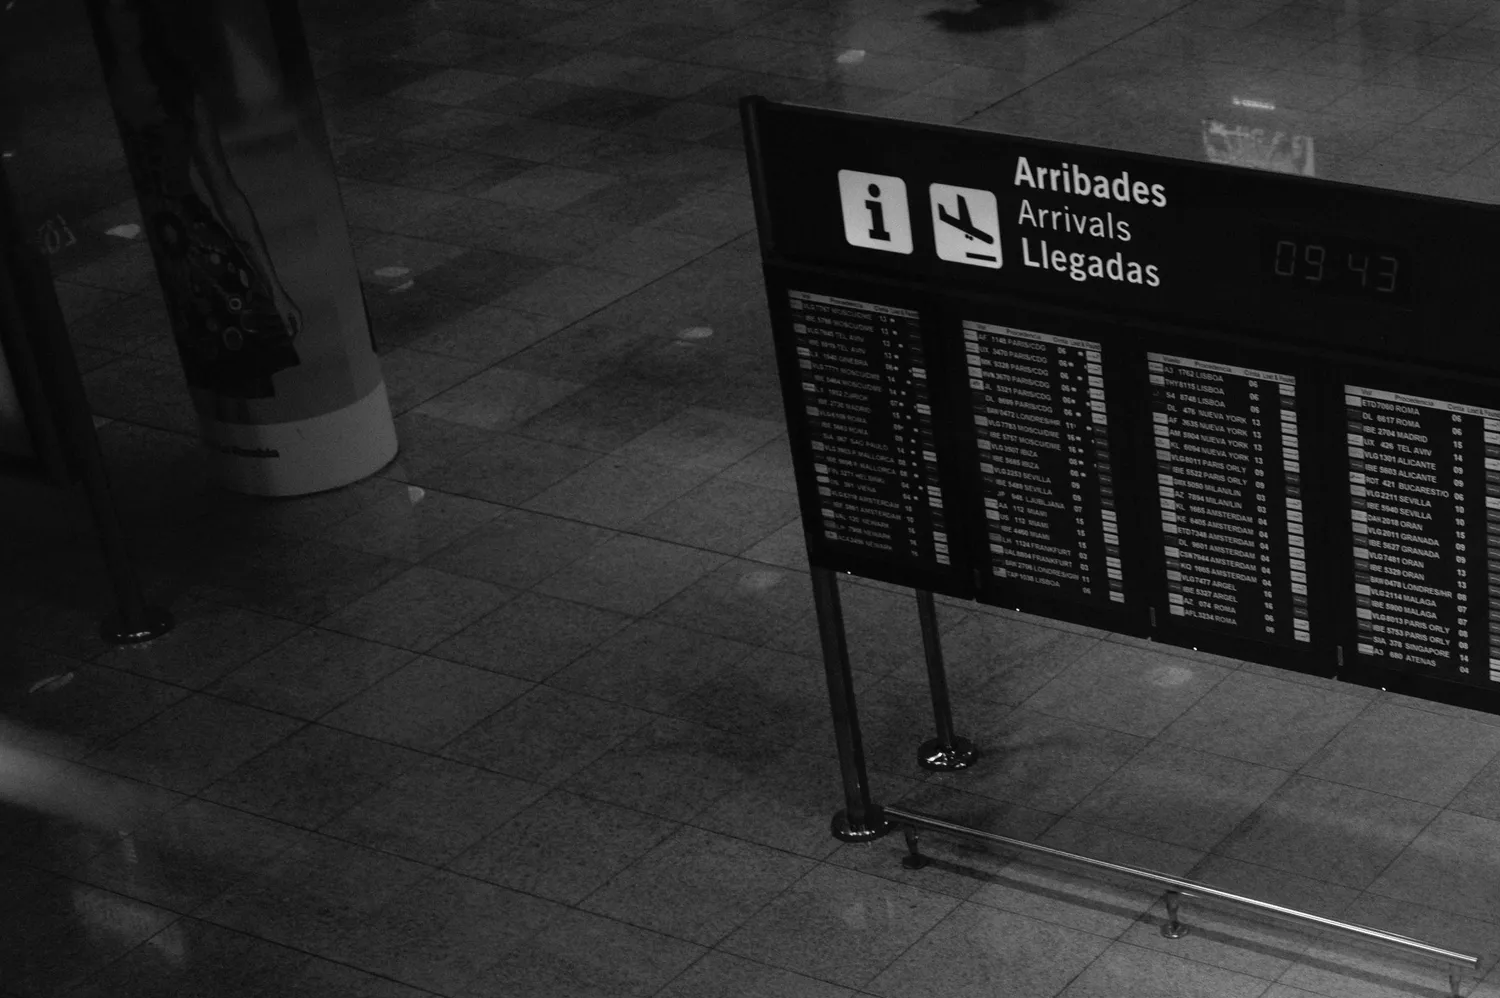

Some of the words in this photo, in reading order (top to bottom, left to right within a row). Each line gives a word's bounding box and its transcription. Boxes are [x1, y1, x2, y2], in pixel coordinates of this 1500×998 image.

[1013, 155, 1168, 209] Arribades
[1017, 198, 1133, 243] Arrivals
[1020, 236, 1162, 289] Llegadas
[1394, 404, 1420, 416] ROMA
[1395, 430, 1428, 443] MADRID
[1452, 440, 1463, 449] 15
[1396, 442, 1412, 453] TEL
[1413, 445, 1432, 457] AVIV
[1396, 456, 1436, 470] ALICANTE
[1398, 494, 1432, 508] SEVILLA
[1397, 520, 1423, 531] ORAN
[1399, 532, 1440, 546] GRANADA
[1400, 593, 1437, 607] MALAGA
[1402, 617, 1427, 630] PARIS
[1428, 622, 1450, 635] ORLY
[1404, 642, 1450, 658] SINGAPORE
[1404, 653, 1436, 667] ATENAS
